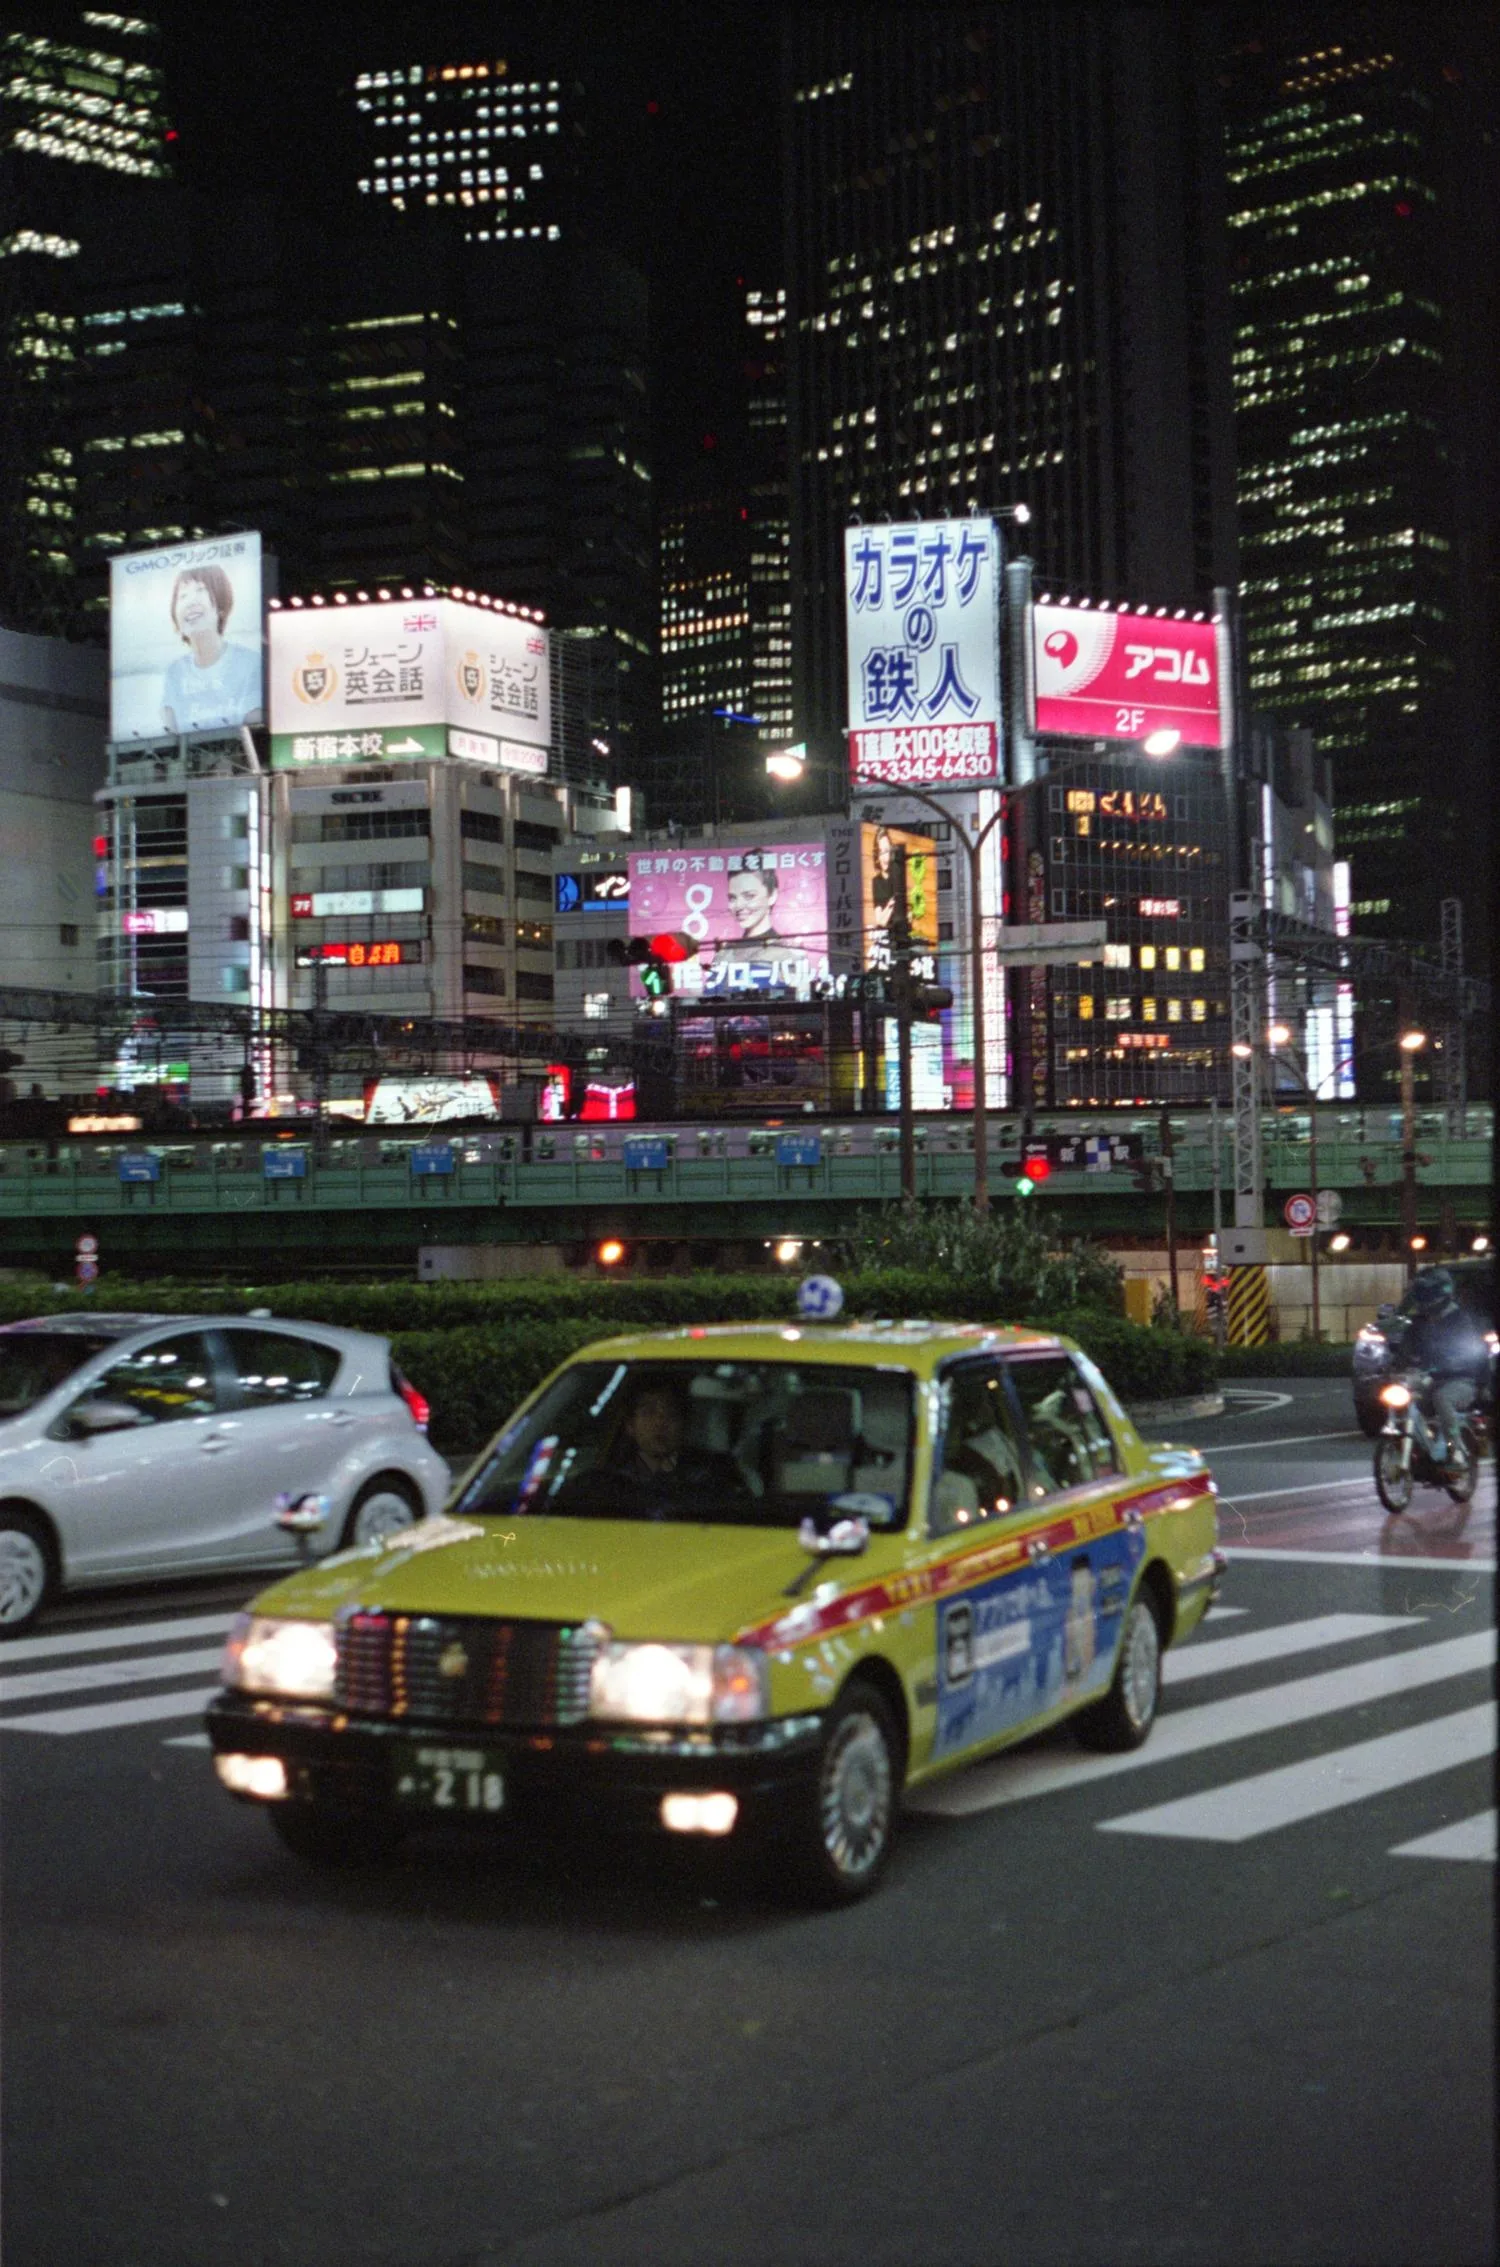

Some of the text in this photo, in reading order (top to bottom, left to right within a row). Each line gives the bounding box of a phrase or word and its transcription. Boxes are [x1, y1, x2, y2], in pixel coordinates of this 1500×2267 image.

[851, 526, 988, 611] カラオケ
[903, 604, 936, 650] の
[344, 643, 424, 667] シェーン
[490, 654, 538, 682] シェーン
[1124, 645, 1211, 686] アコム
[344, 666, 424, 695] 英会話
[490, 678, 539, 711] 英会話
[861, 646, 981, 721] 鉄人
[1116, 710, 1145, 732] 2F
[293, 733, 382, 760] 新宿本校
[857, 756, 992, 783] 03-3345-6430
